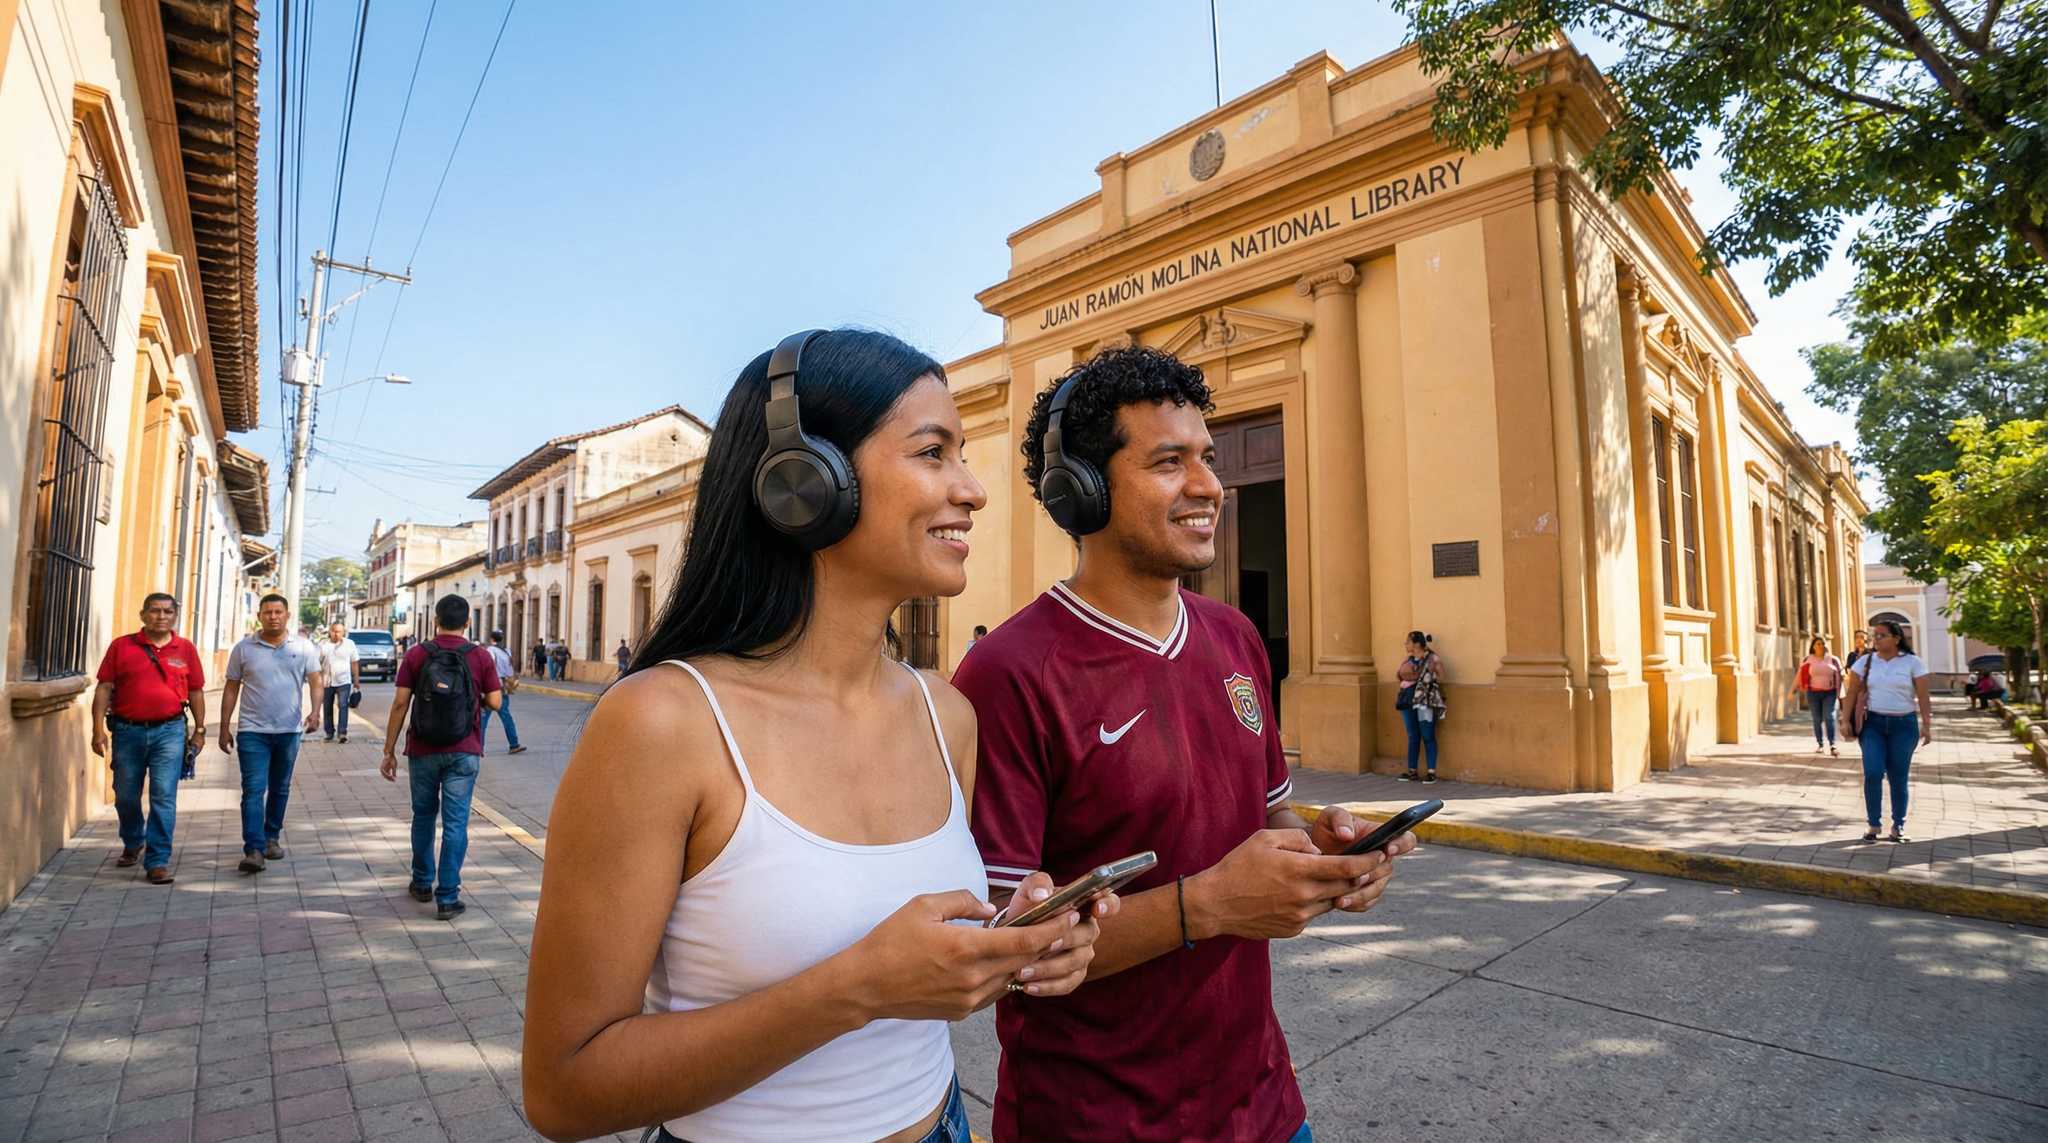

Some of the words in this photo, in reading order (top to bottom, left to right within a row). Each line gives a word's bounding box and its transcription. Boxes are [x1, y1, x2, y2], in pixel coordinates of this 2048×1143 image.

[1040, 299, 1080, 330] JUAN
[1151, 247, 1222, 291] MOLINA
[1230, 206, 1340, 262] NATIONAL
[1351, 157, 1464, 220] LIBRARY
